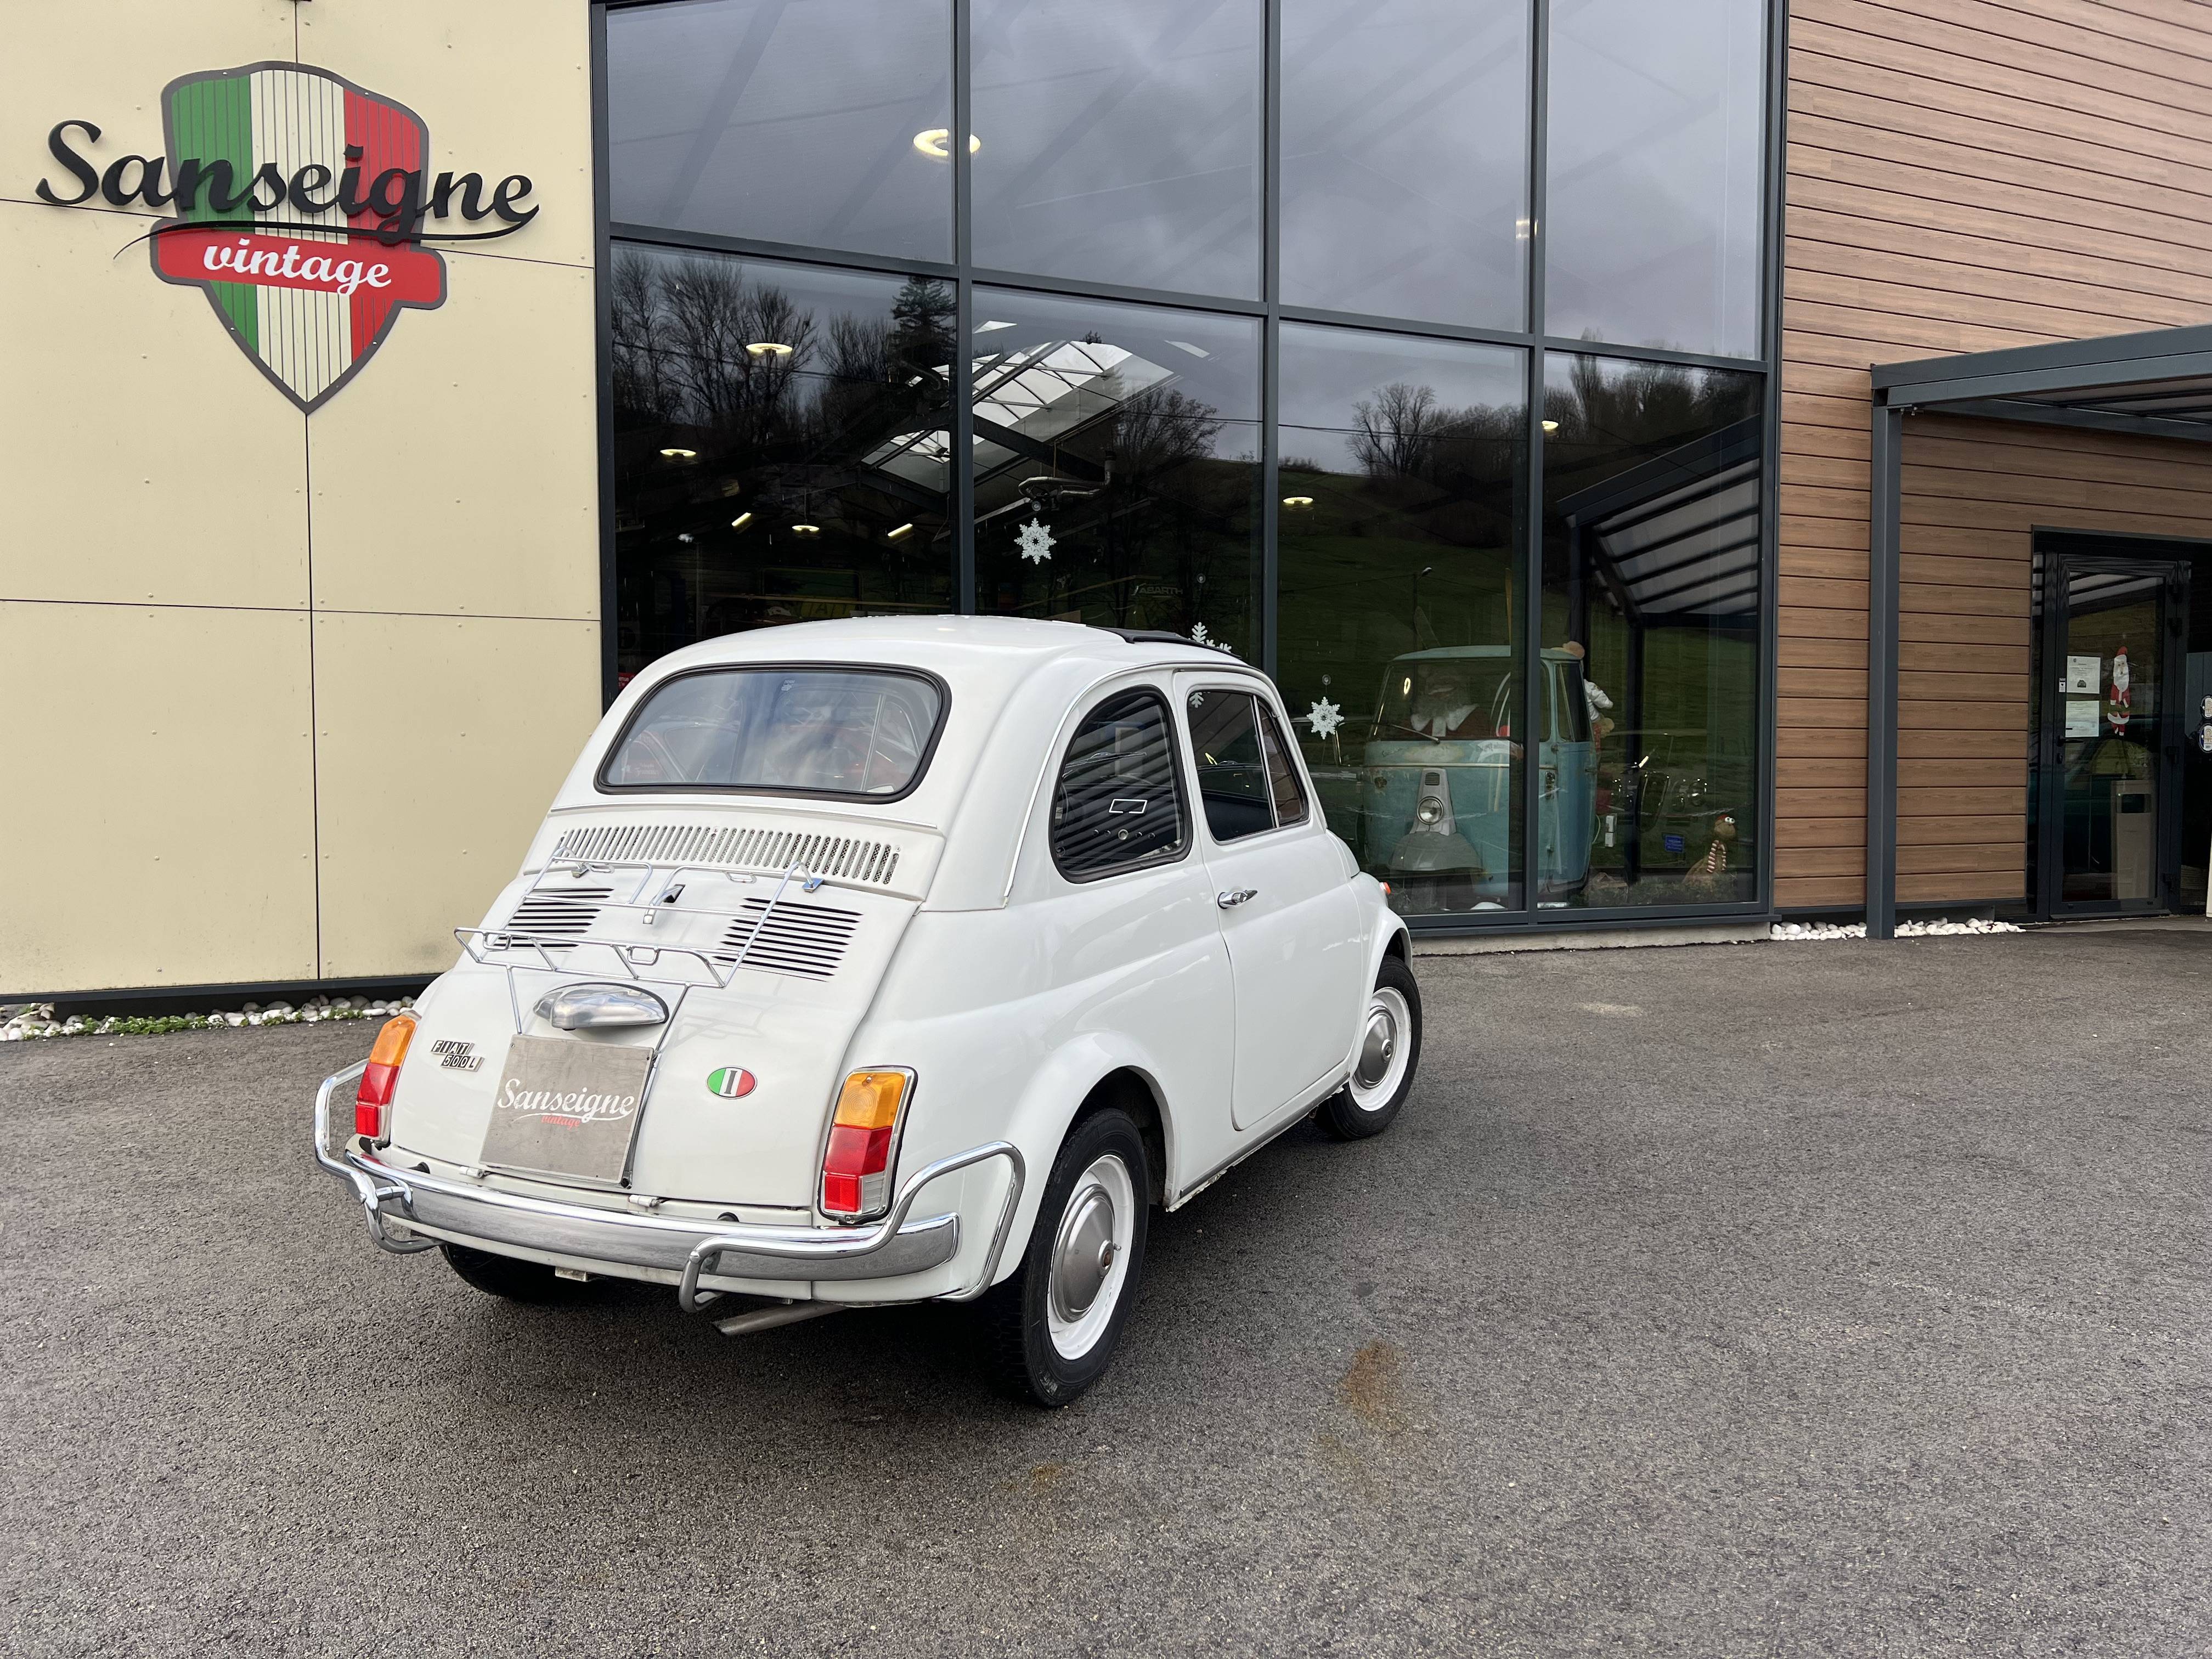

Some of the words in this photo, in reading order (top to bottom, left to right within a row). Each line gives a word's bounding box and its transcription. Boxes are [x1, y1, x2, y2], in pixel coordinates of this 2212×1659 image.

[36, 120, 539, 244] Sanseigne
[203, 238, 392, 296] vintage
[1139, 586, 1183, 595] ABARTH
[432, 1041, 469, 1054] FIAT
[443, 1055, 476, 1069] 500L
[497, 1079, 634, 1123] Sanseigne
[541, 1115, 580, 1130] vintage
